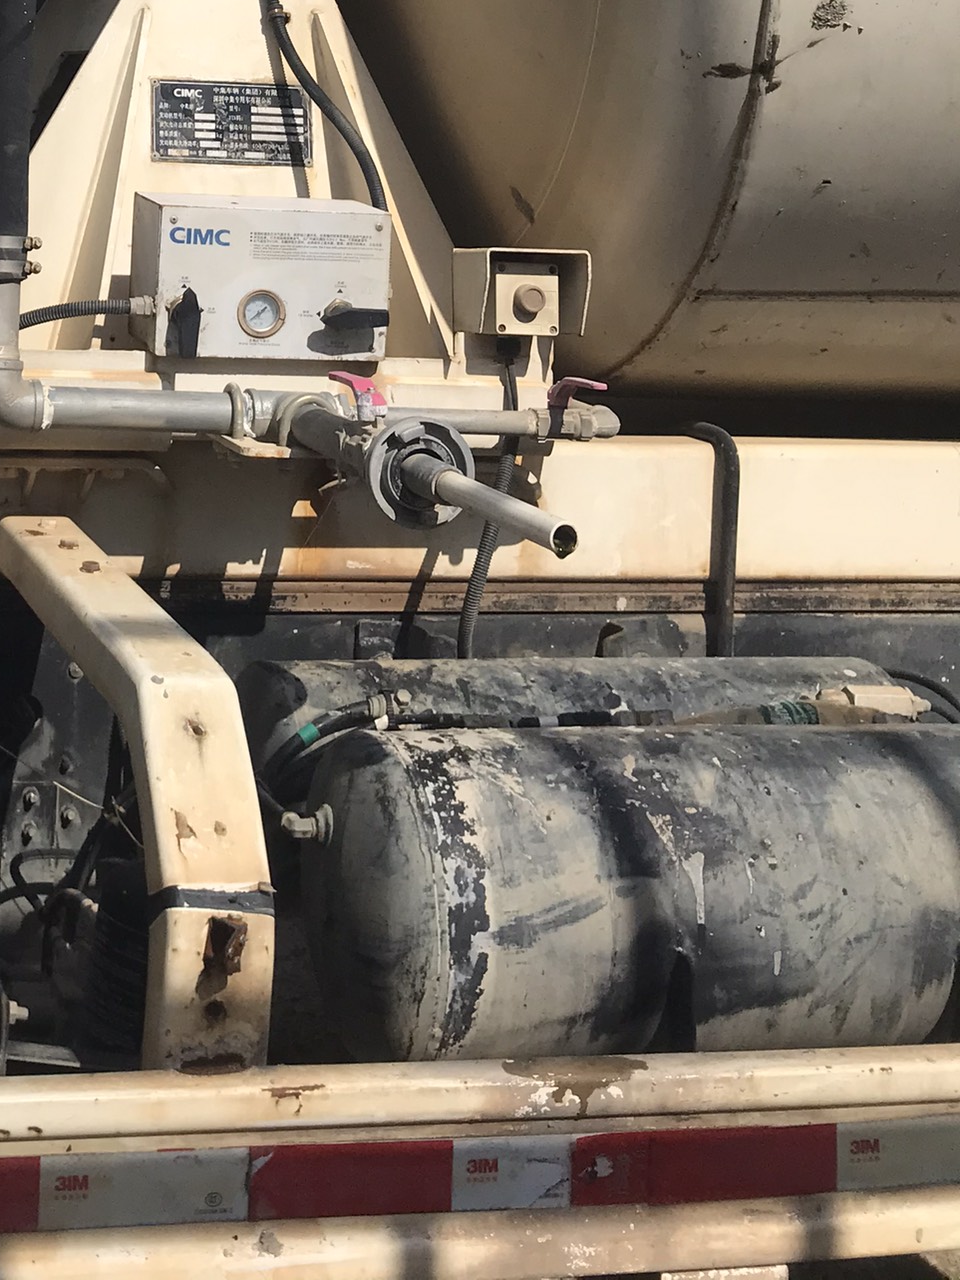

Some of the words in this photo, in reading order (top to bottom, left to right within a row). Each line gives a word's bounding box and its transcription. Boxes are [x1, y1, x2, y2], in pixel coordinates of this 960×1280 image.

[173, 87, 203, 98] CIMC
[169, 226, 231, 246] CIMC
[848, 1138, 880, 1155] 3M
[467, 1158, 499, 1174] 3M
[54, 1174, 89, 1192] 3M
